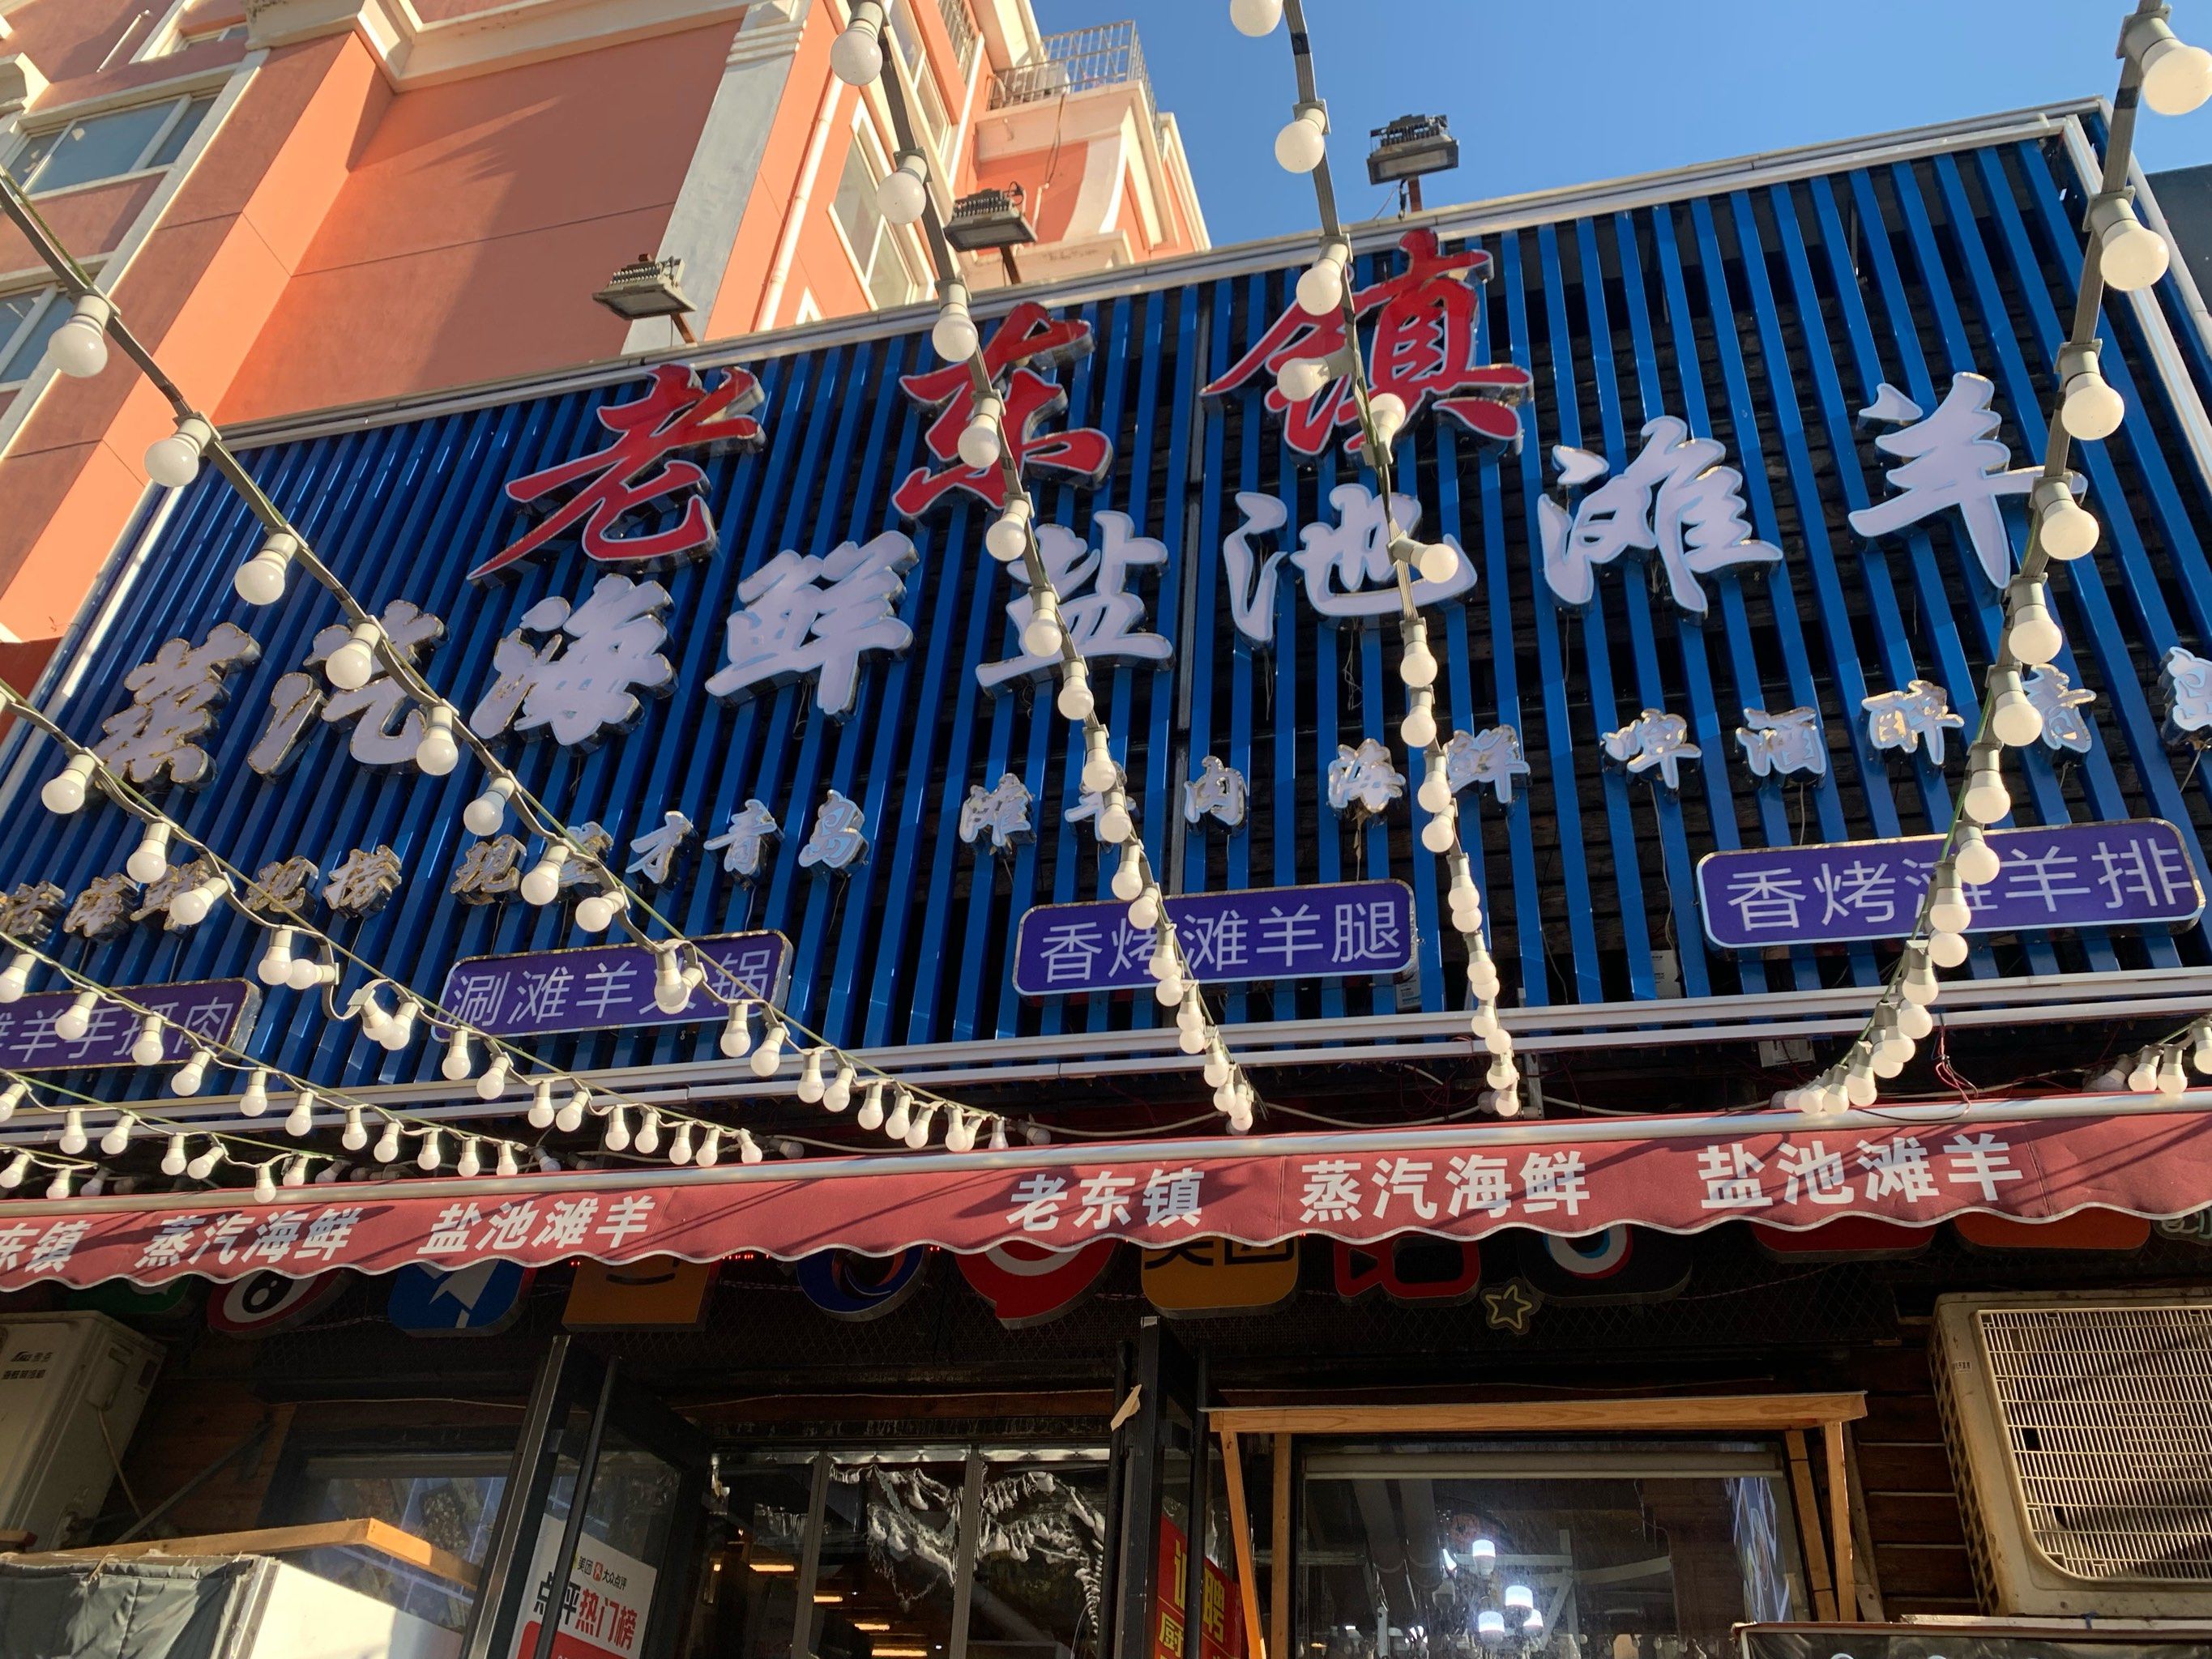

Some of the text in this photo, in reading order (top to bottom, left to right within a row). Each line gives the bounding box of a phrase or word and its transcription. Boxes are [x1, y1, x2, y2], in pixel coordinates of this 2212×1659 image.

[1040, 901, 1403, 983] 香烤滩羊腿
[0, 996, 233, 1063] 羊手抓肉
[1006, 1133, 2024, 1232] 老东镇 蒸汽海鲜 盐池滩羊
[134, 1207, 363, 1269] 蒸汽海鲜
[416, 1195, 655, 1255] 盐池滩羊
[602, 1569, 627, 1591] 大众点评
